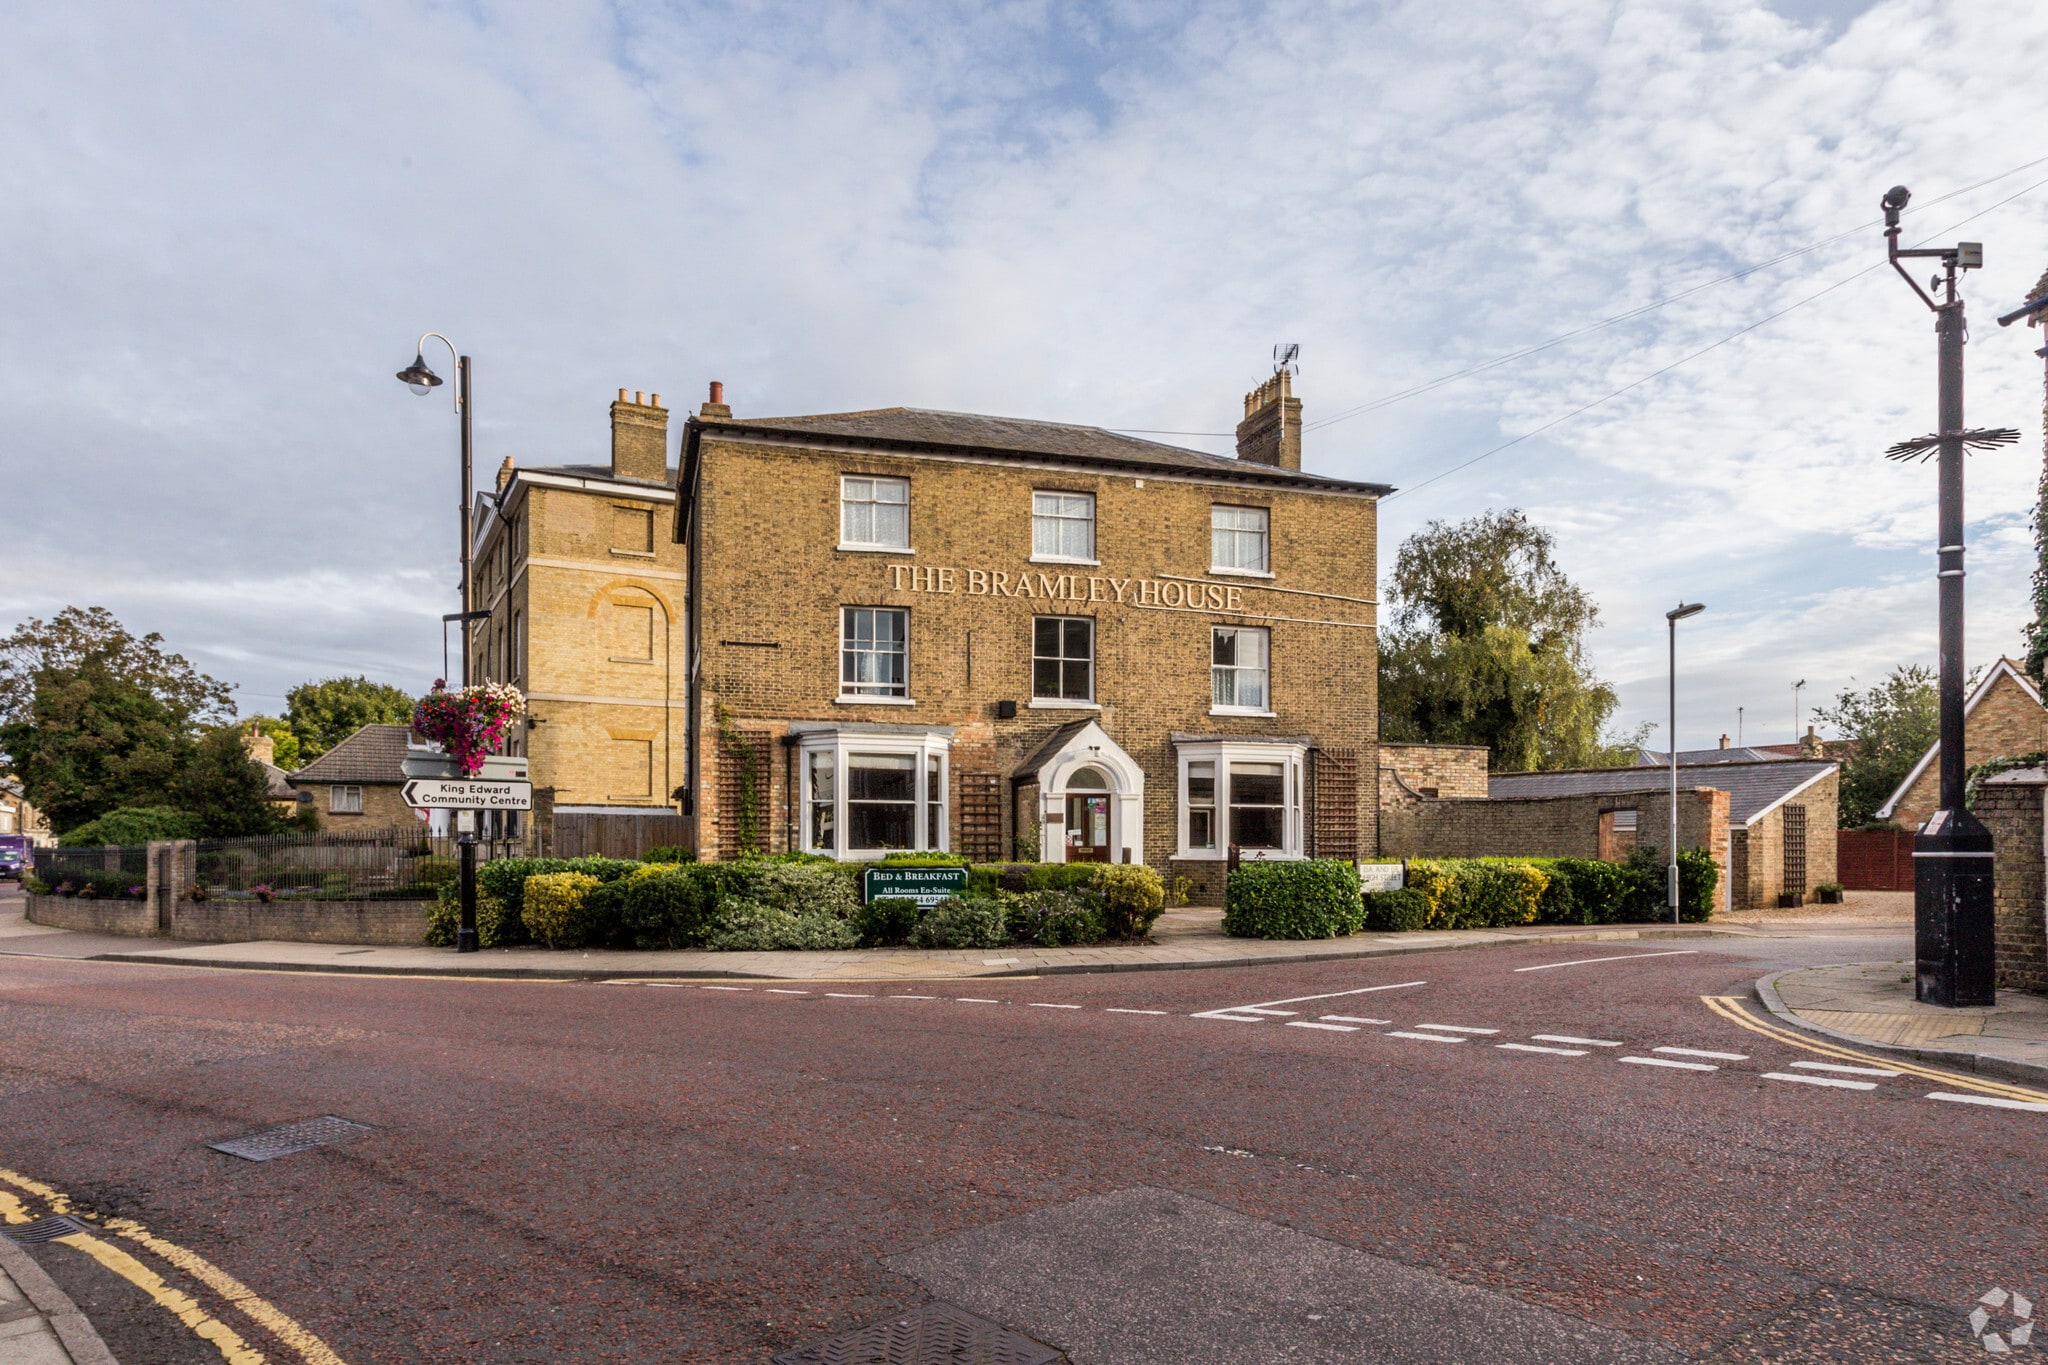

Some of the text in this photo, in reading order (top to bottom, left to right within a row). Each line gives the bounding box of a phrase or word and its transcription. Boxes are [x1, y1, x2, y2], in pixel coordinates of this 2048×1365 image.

[887, 564, 1243, 611] THE BRAMLEY HOUSE
[440, 784, 511, 794] King Edward
[422, 794, 528, 805] Community Centre
[1380, 873, 1401, 881] STREET
